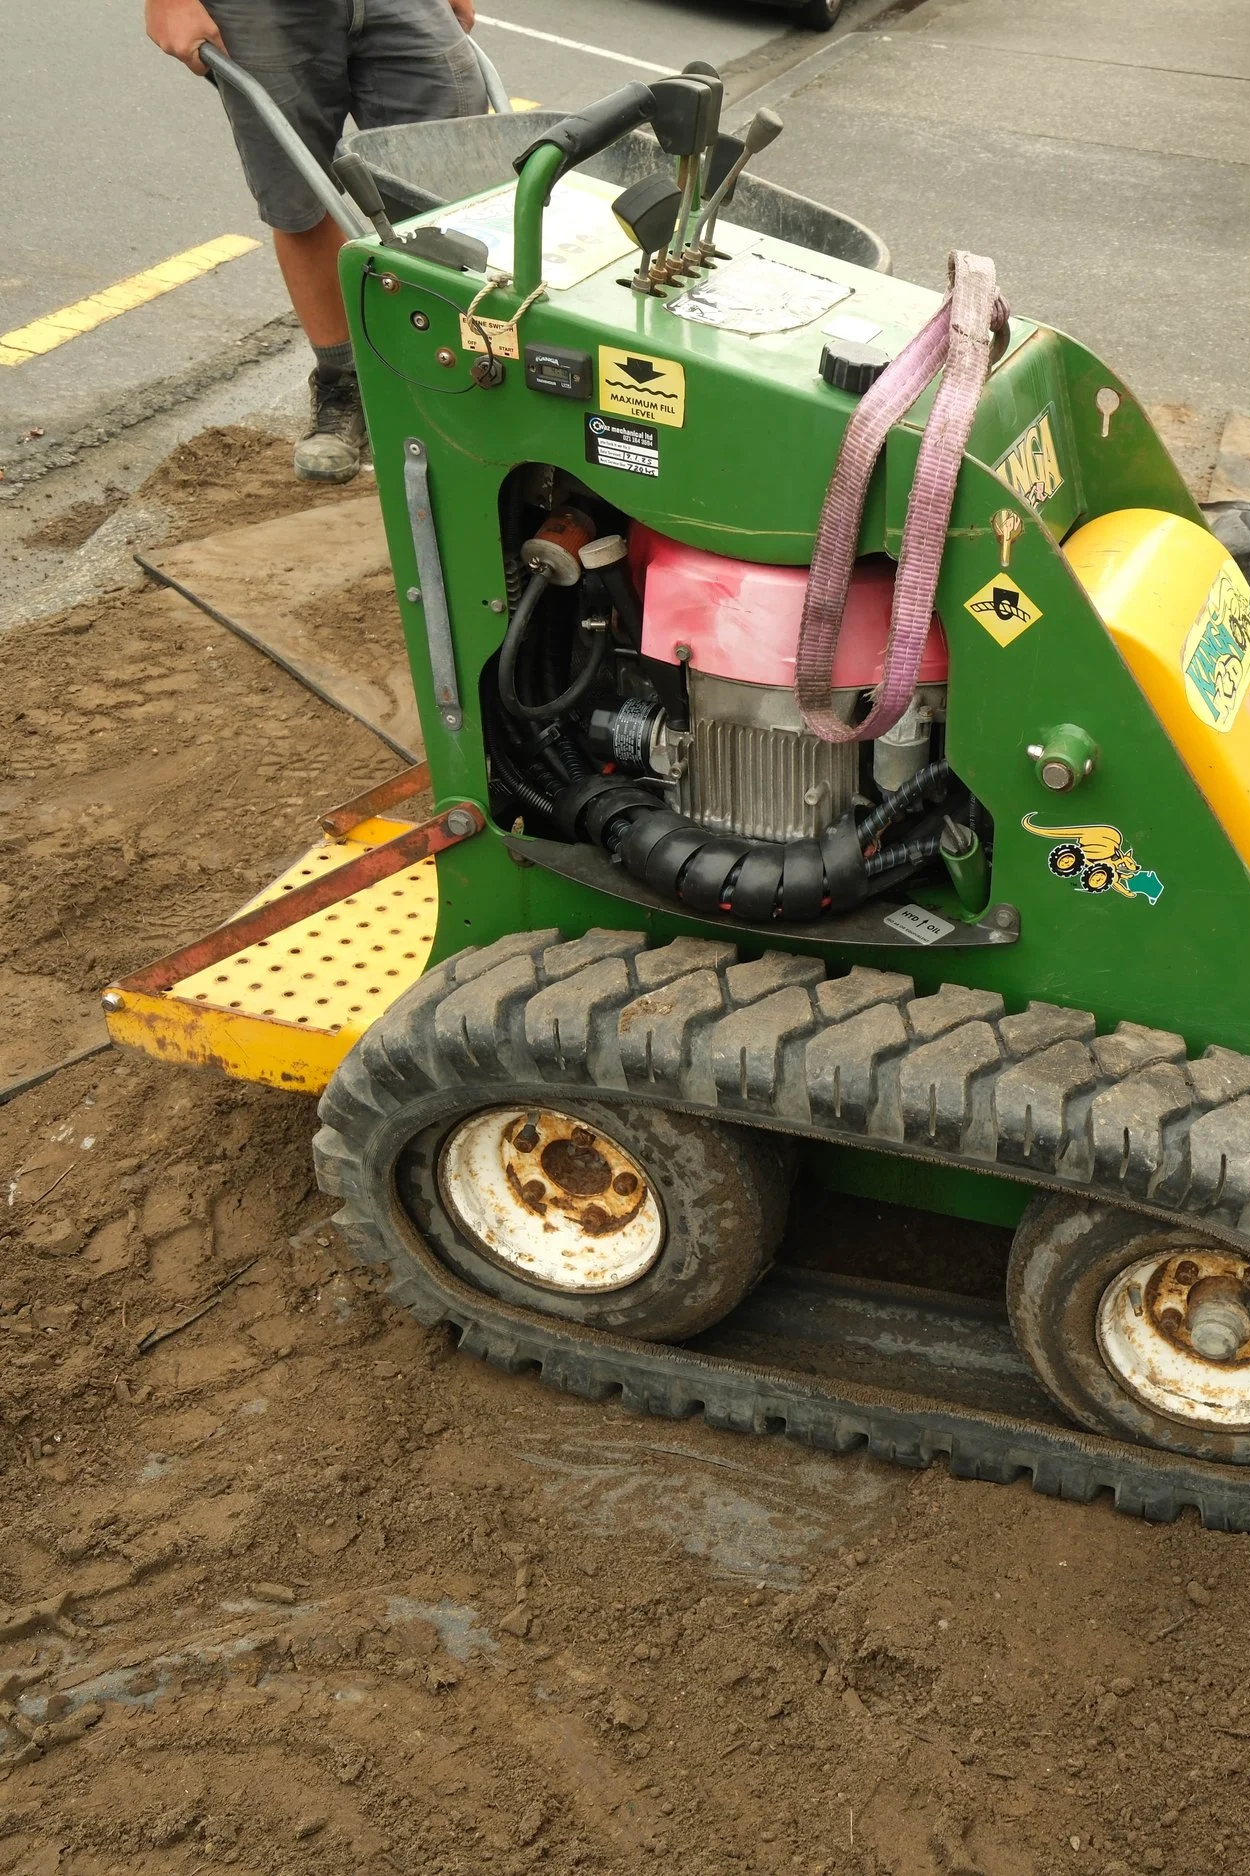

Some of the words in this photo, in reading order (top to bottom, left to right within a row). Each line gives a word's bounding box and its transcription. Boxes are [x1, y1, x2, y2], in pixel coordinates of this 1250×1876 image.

[463, 317, 487, 327] ENE
[488, 322, 514, 332] SWITH
[611, 394, 658, 411] MAXIMUM
[660, 404, 676, 414] FILL
[631, 408, 655, 420] LEVEL
[611, 427, 644, 438] mechanical
[902, 911, 919, 922] HYD
[927, 925, 941, 934] OIL
